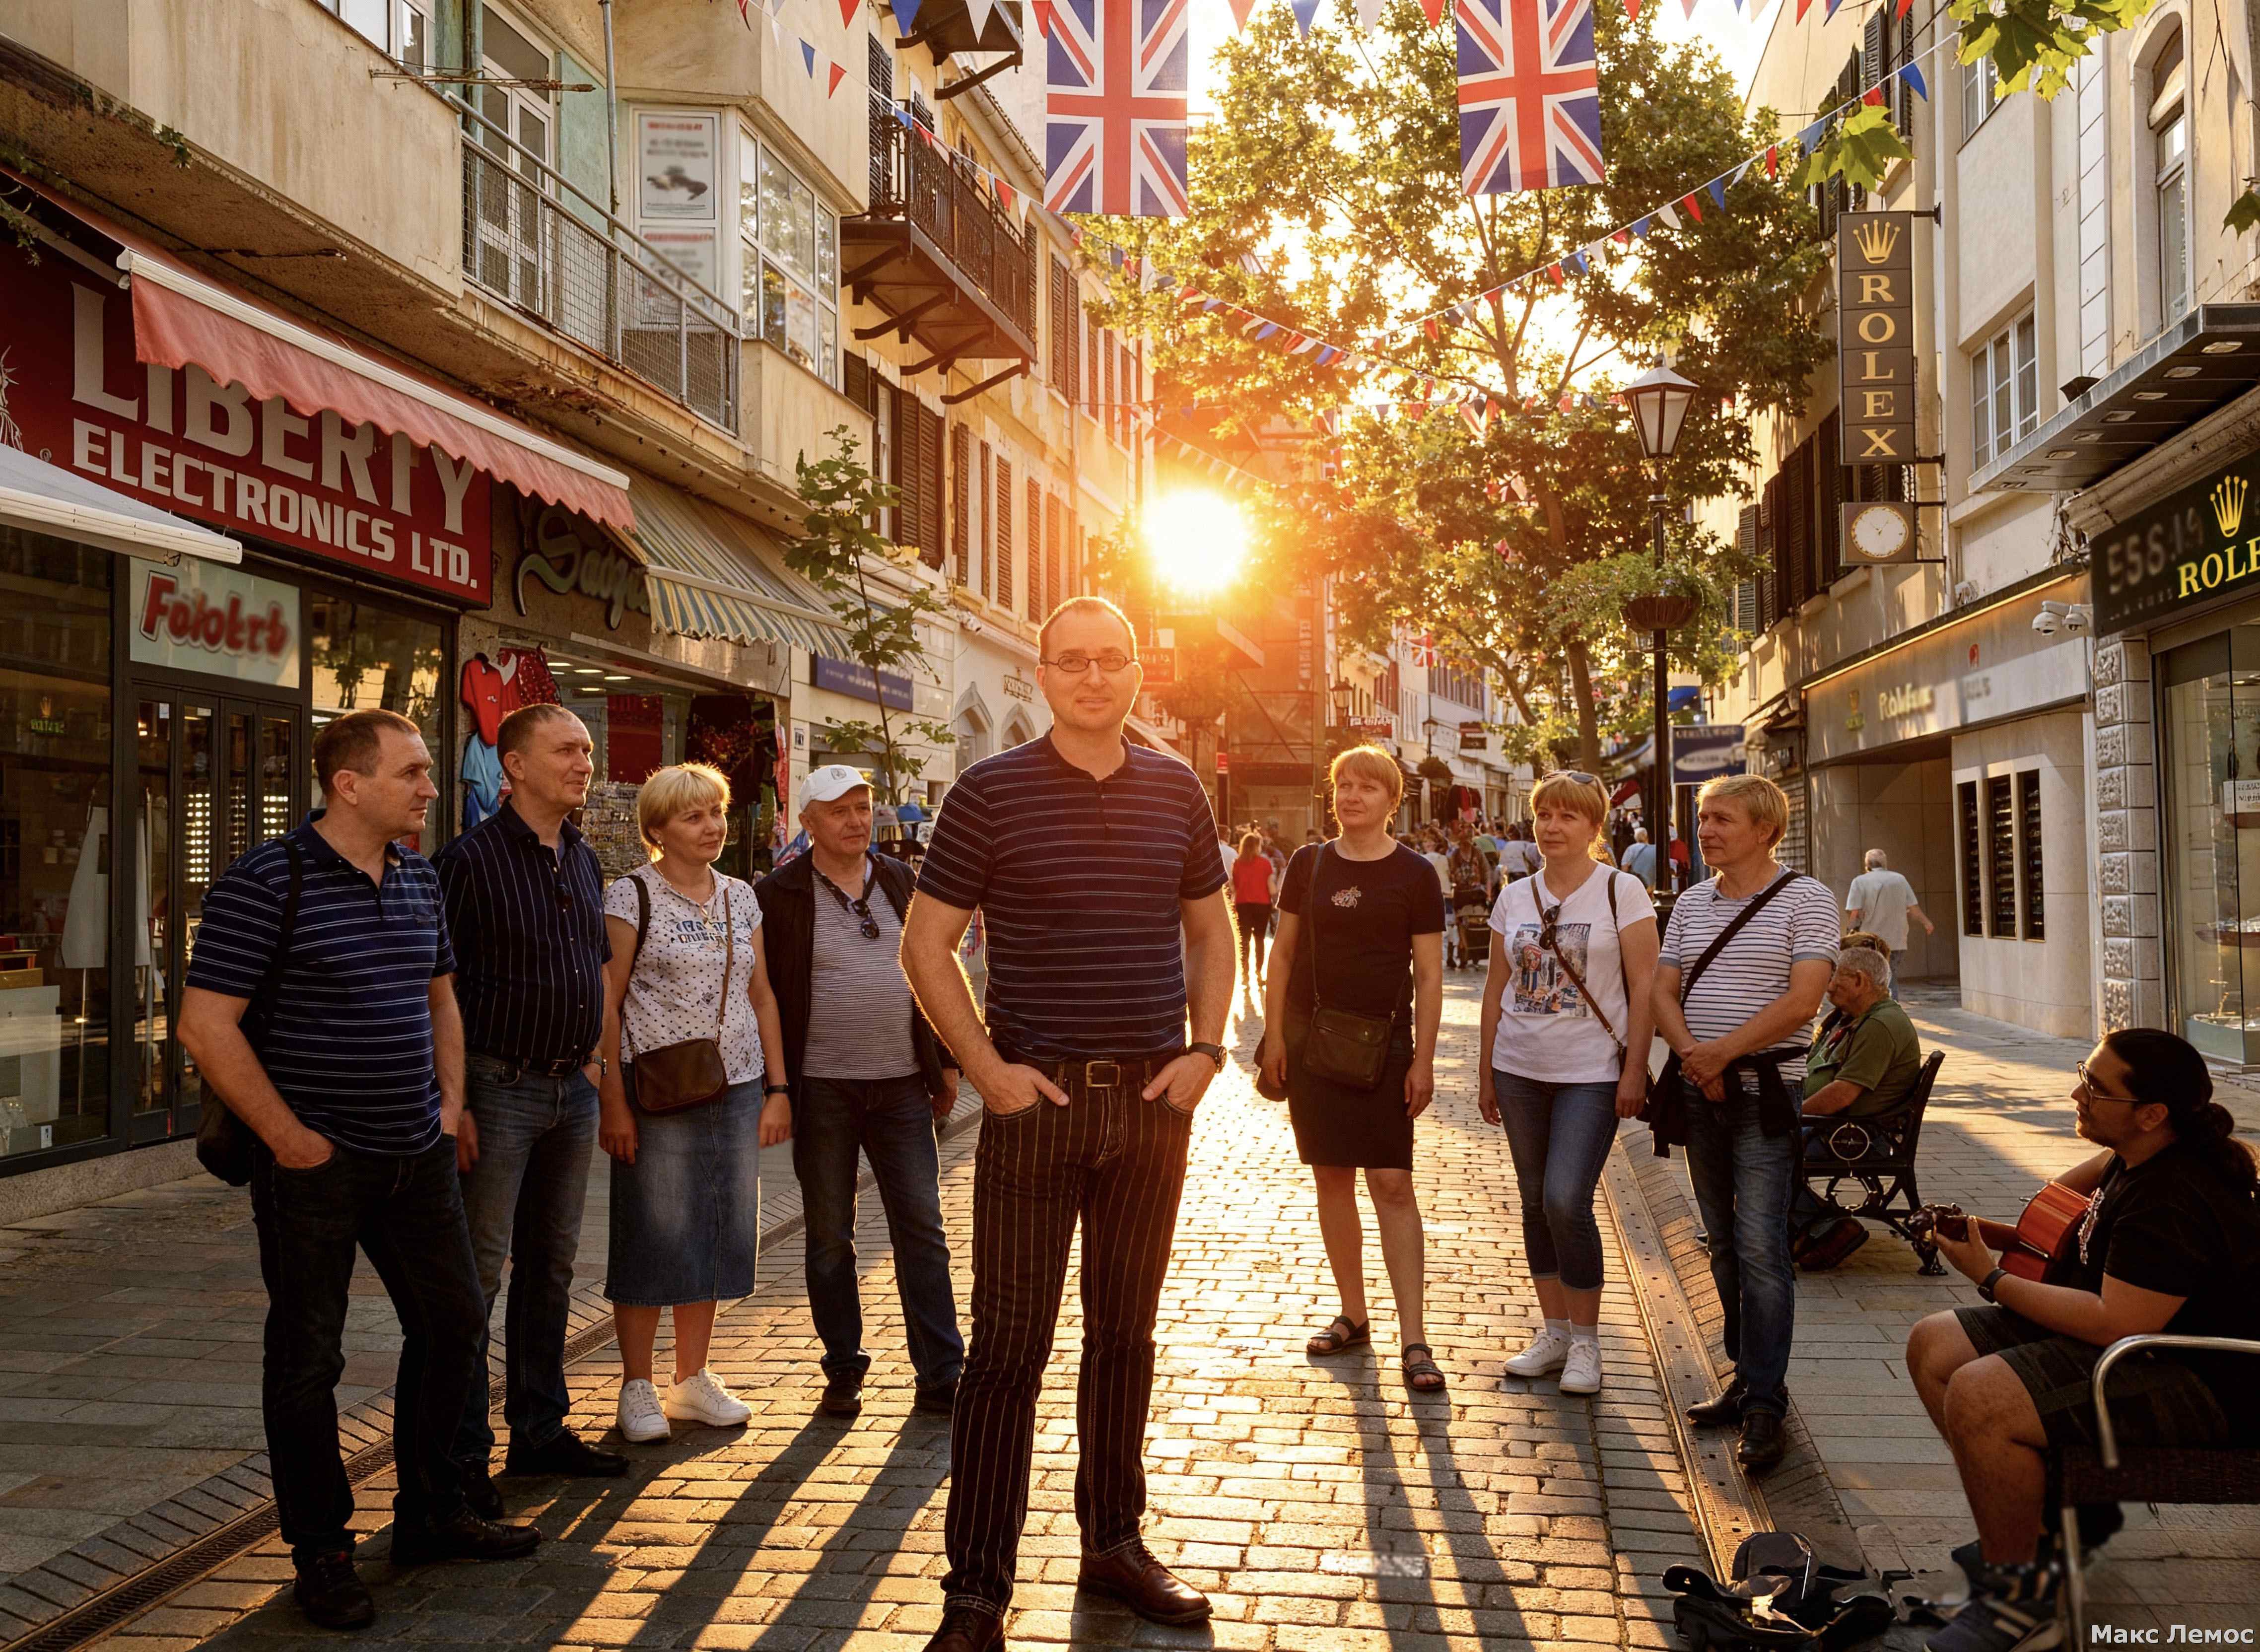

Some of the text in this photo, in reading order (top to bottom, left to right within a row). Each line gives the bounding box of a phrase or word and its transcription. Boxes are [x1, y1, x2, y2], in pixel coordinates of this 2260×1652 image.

[71, 282, 475, 536] LIBERTY
[1857, 274, 1897, 457] ROLEX
[73, 418, 396, 563] ELECTRONICS
[411, 531, 478, 589] LTD.
